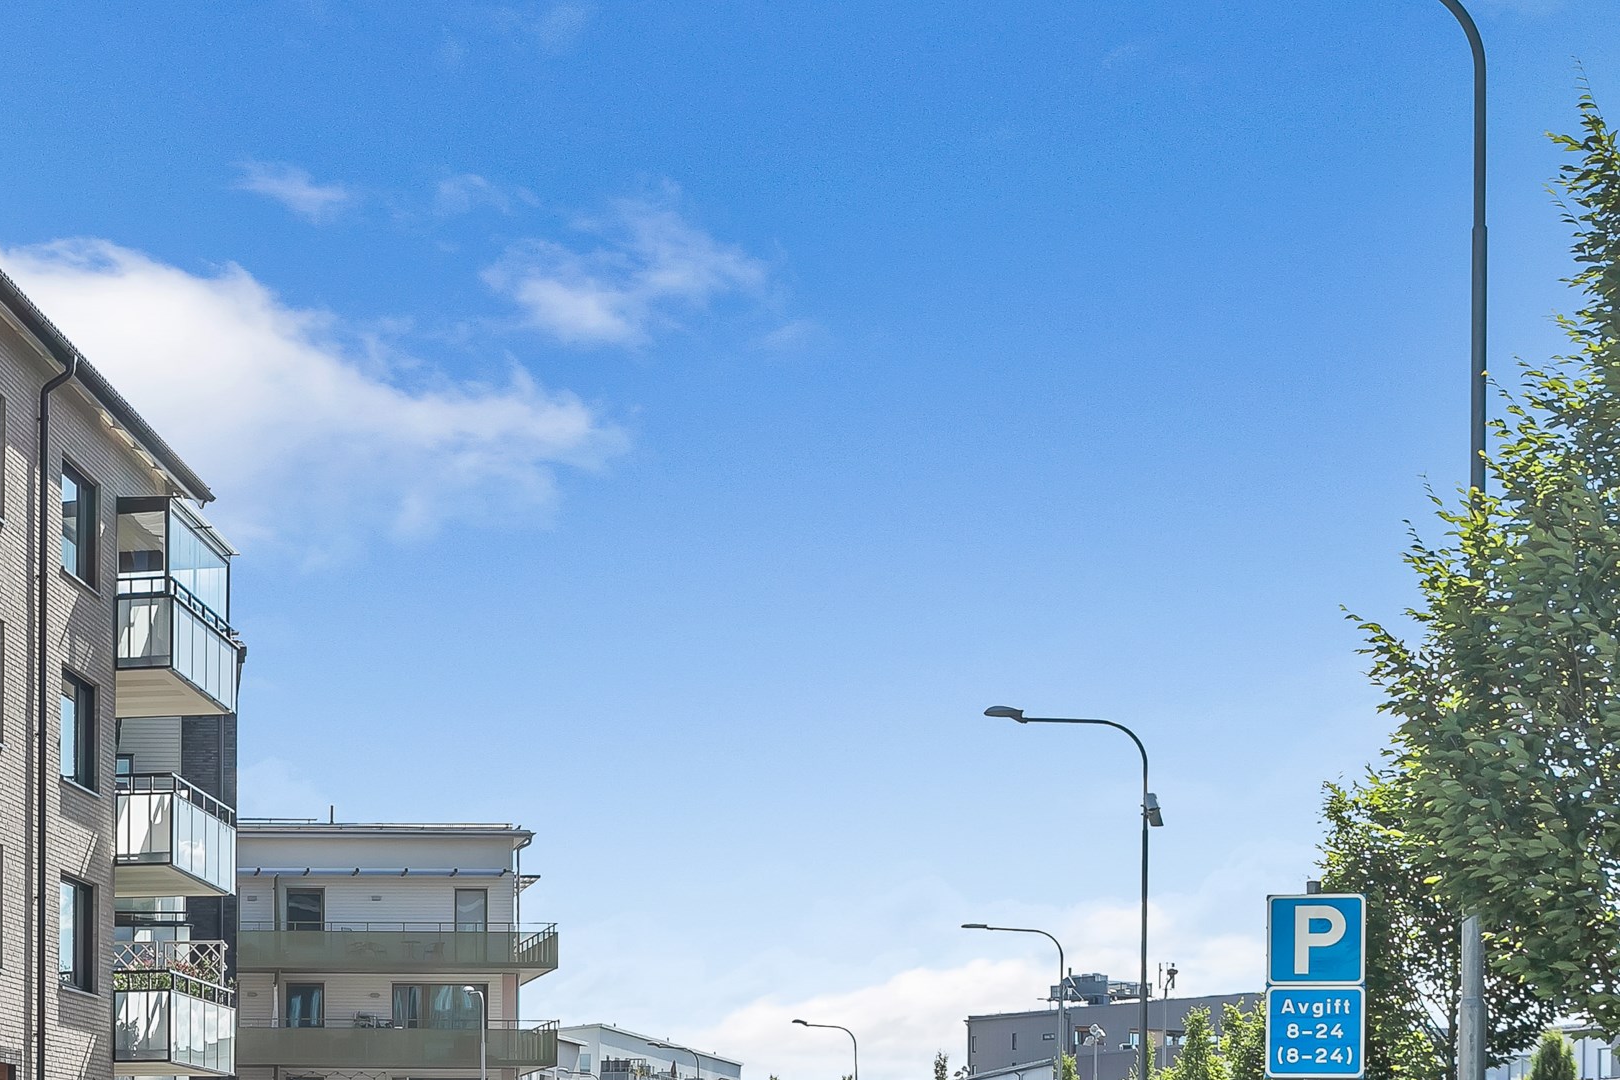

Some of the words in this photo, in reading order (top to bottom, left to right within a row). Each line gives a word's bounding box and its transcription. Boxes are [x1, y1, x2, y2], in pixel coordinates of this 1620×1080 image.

[1294, 905, 1347, 975] P
[1281, 998, 1351, 1018] Avgift
[1286, 1023, 1344, 1039] 8-24
[1277, 1046, 1354, 1065] (8-24)
